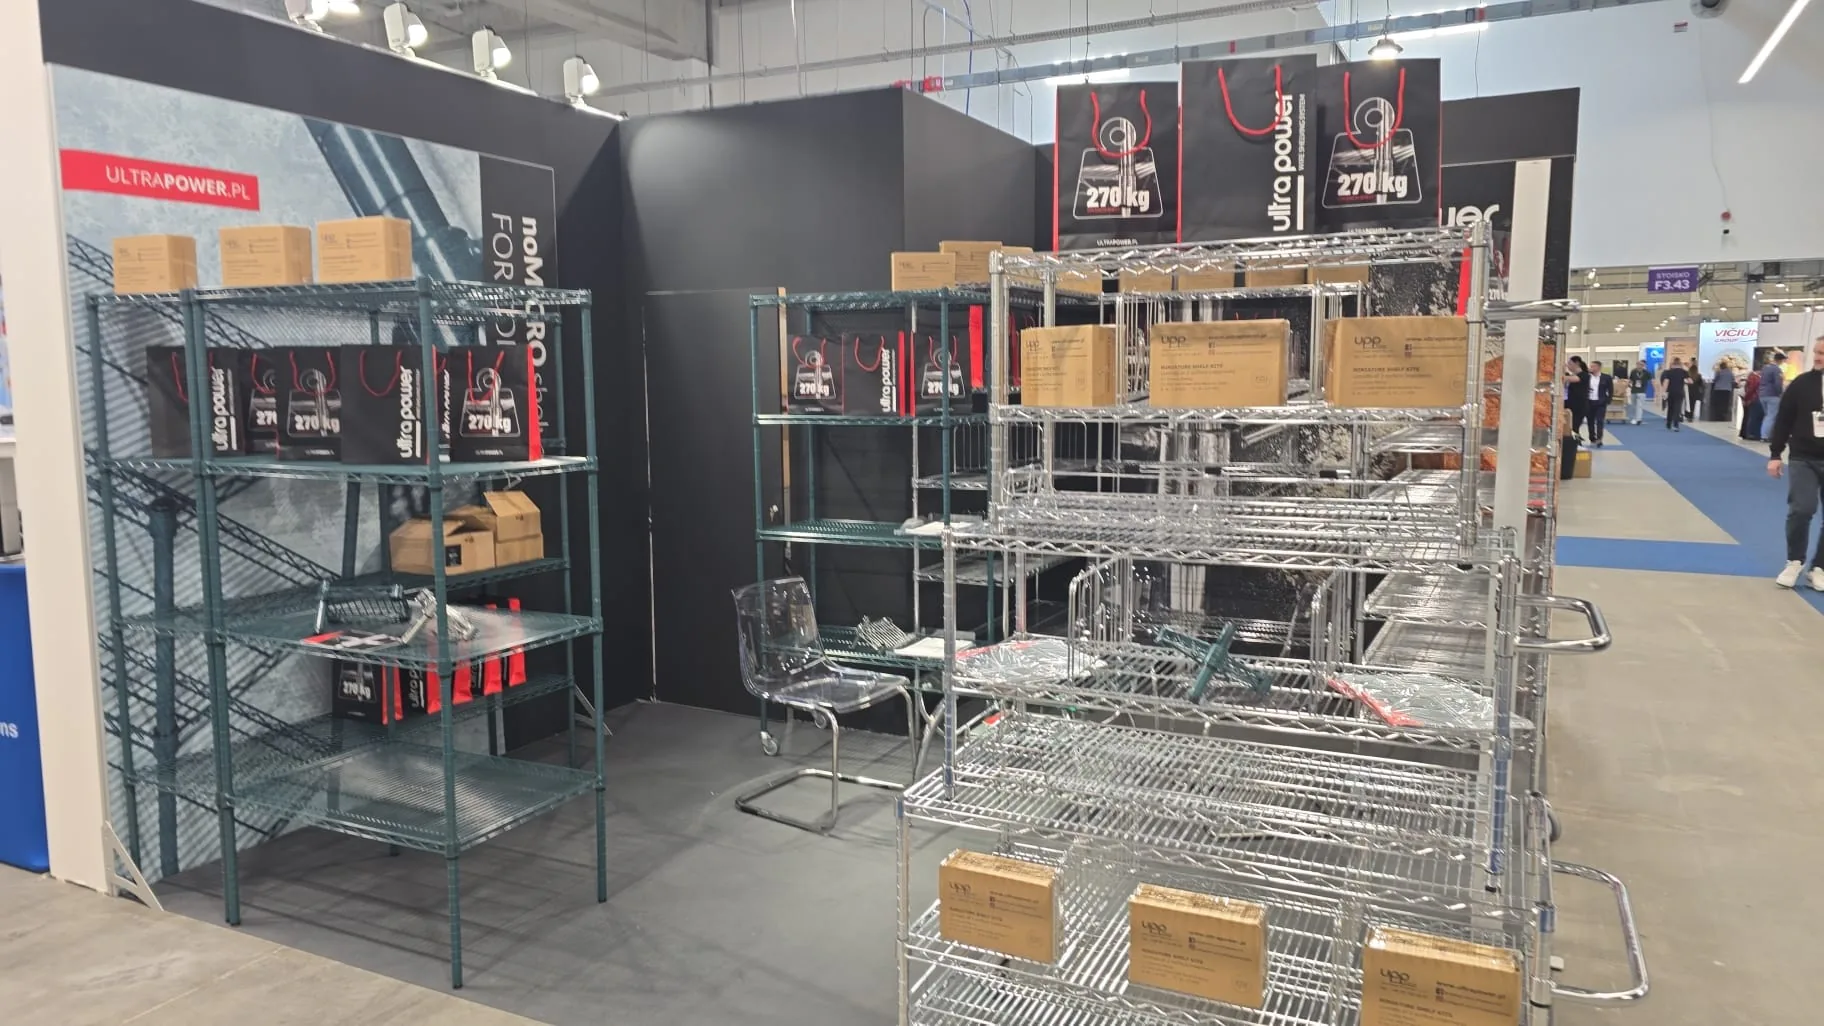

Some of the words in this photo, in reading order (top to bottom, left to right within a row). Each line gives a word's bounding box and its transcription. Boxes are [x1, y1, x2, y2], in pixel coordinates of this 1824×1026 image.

[1273, 90, 1297, 173] power
[105, 165, 251, 201] ULTRAPOWER.PL
[1337, 172, 1376, 197] 270
[1382, 171, 1408, 198] kg
[1086, 186, 1122, 209] 270
[1126, 186, 1150, 212] kg
[1268, 175, 1292, 232] ultra
[491, 212, 514, 282] FOR
[1655, 280, 1690, 291] F3.43
[1656, 271, 1690, 280] STOISKO
[522, 216, 547, 368] noMCRO
[1161, 335, 1186, 349] upp
[1354, 335, 1382, 349] upp
[400, 365, 416, 420] power
[800, 383, 816, 395] 270
[818, 384, 830, 396] kg
[880, 386, 892, 413] ultra
[211, 416, 229, 451] ultra
[294, 414, 319, 431] 270
[468, 414, 492, 431] 270
[494, 413, 512, 434] kg
[396, 420, 413, 458] ultra
[1141, 920, 1168, 936] upp
[1379, 967, 1411, 984] upp
